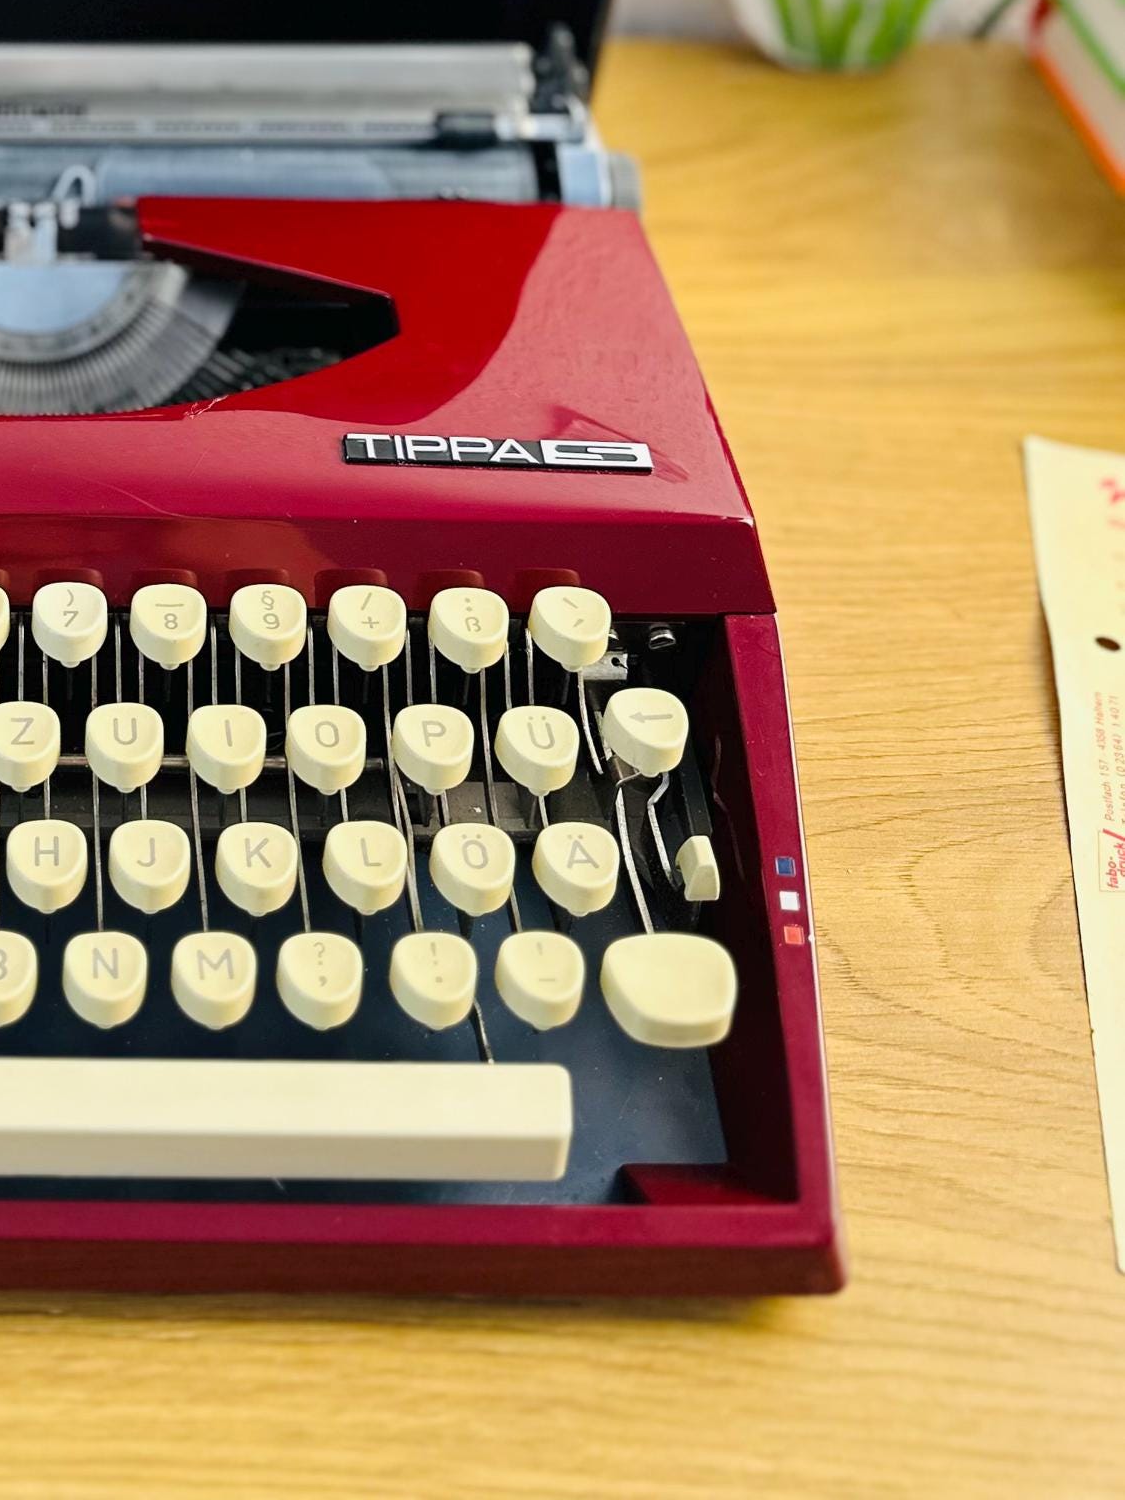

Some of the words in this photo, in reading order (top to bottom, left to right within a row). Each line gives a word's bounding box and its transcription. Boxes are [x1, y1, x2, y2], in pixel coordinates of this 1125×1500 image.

[347, 433, 540, 465] TIPPA
[66, 589, 75, 607] )
[261, 590, 275, 611] §
[63, 610, 79, 627] 7
[164, 613, 178, 630] 8
[263, 613, 281, 630] 9
[465, 616, 482, 633] ß
[11, 717, 35, 745] Z
[113, 717, 137, 746] U
[225, 719, 233, 747] I
[315, 721, 340, 748] O
[422, 720, 447, 747] P
[527, 715, 555, 750] Ü
[34, 836, 60, 867] H
[136, 837, 156, 867] J
[245, 837, 272, 869] K
[360, 838, 383, 867] L
[462, 834, 489, 870] Ö
[567, 834, 600, 870] Ä
[92, 948, 119, 980] N
[197, 948, 235, 980] M
[313, 942, 326, 966] ?
[430, 942, 438, 966] !
